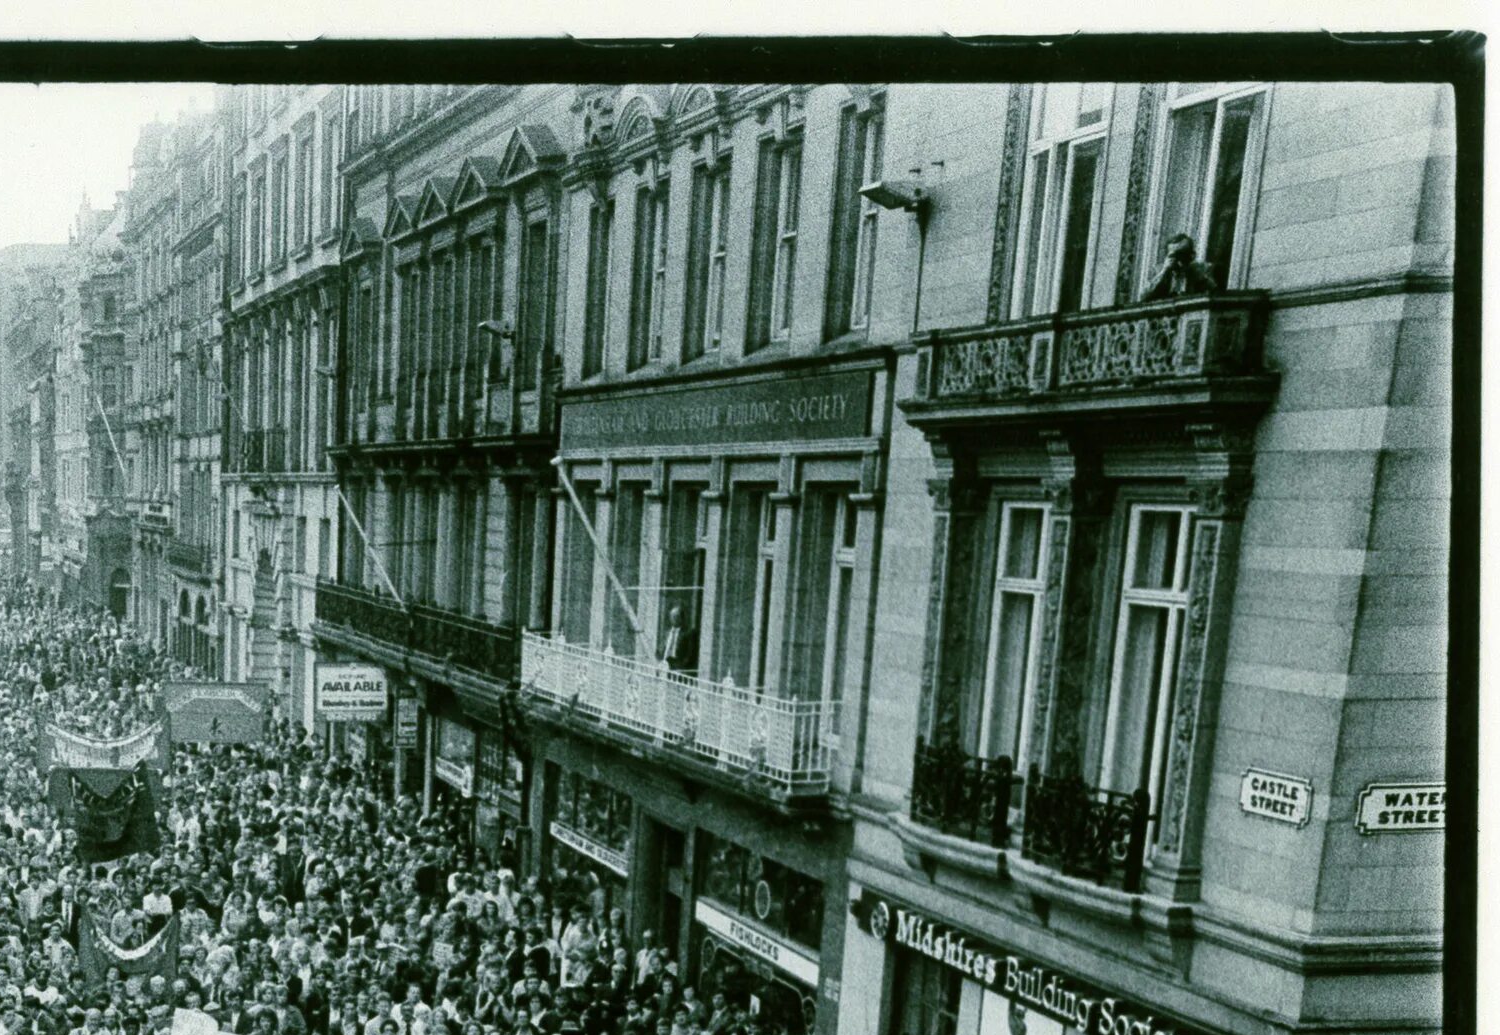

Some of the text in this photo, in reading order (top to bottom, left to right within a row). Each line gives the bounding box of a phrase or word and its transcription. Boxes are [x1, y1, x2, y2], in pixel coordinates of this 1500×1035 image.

[789, 394, 849, 423] SOCIETY
[322, 681, 383, 692] AVAILABLE
[1251, 777, 1299, 800] CASTLE
[1385, 791, 1445, 807] WATE
[1250, 795, 1296, 817] STREET
[729, 921, 780, 962] FISHLOCKS
[895, 908, 997, 985] Midshires
[1004, 955, 1094, 1033] Building
